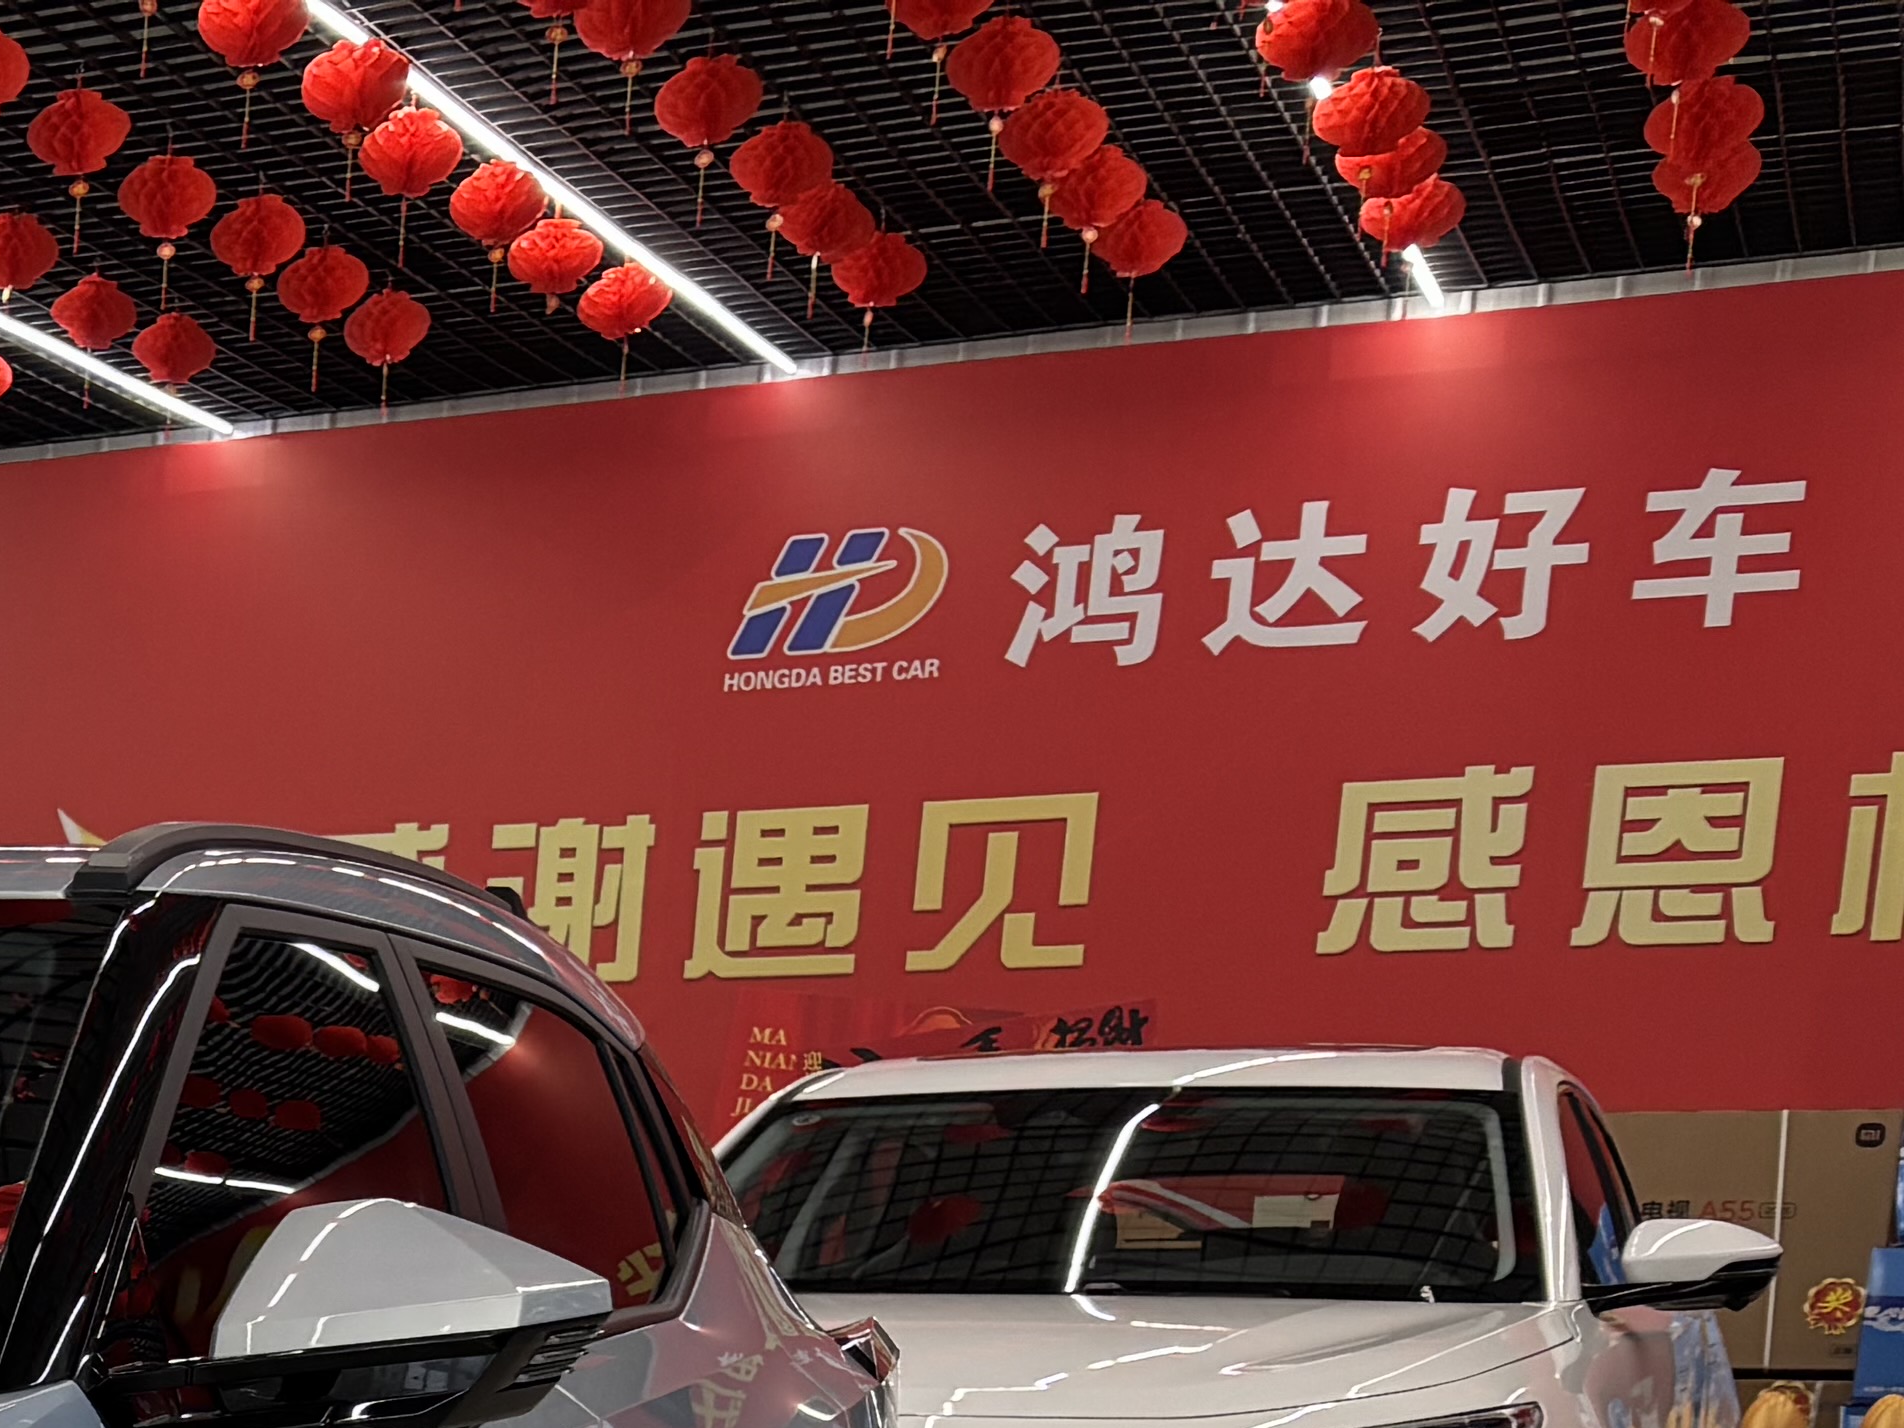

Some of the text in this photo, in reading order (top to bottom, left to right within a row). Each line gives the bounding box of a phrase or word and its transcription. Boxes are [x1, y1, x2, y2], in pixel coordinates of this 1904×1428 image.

[1004, 467, 1808, 669] 鸿达好车
[723, 657, 941, 693] HONGDA BEST CAR
[321, 791, 1101, 984] 谢遇见
[749, 1026, 787, 1046] MA
[802, 1050, 823, 1074] 迎
[740, 1073, 773, 1092] DA
[1697, 1200, 1755, 1222] A55
